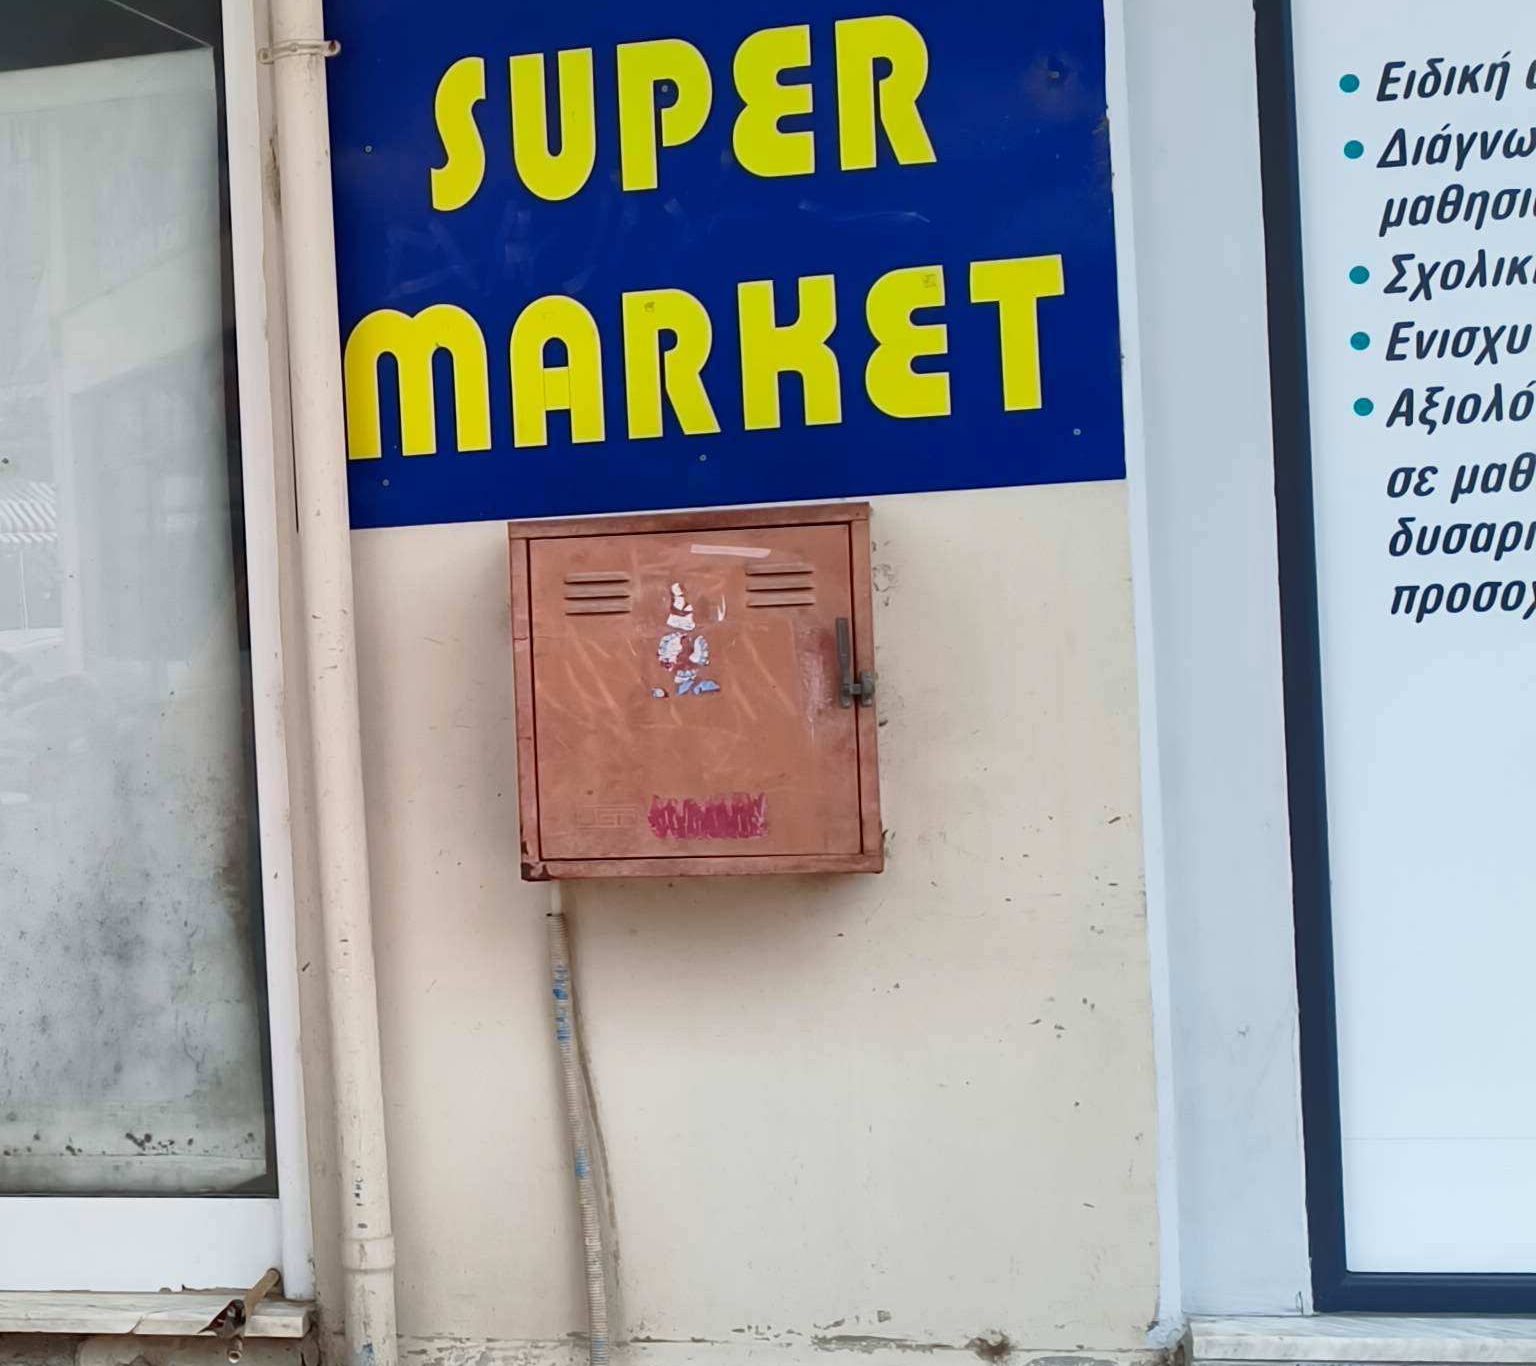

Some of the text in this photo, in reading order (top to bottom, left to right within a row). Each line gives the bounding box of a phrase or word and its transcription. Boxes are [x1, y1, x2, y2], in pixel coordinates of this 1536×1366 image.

[1376, 51, 1511, 102] Ειδική
[430, 14, 937, 212] SUPER
[1376, 123, 1536, 172] Διάγνω
[1378, 183, 1536, 237] μαθησι
[1382, 249, 1536, 302] Σχολικ
[344, 253, 1065, 461] MARKET
[1385, 321, 1533, 366] Ενισχυ
[1386, 380, 1536, 435] Αξιολό
[1386, 452, 1536, 504] σε μαθ
